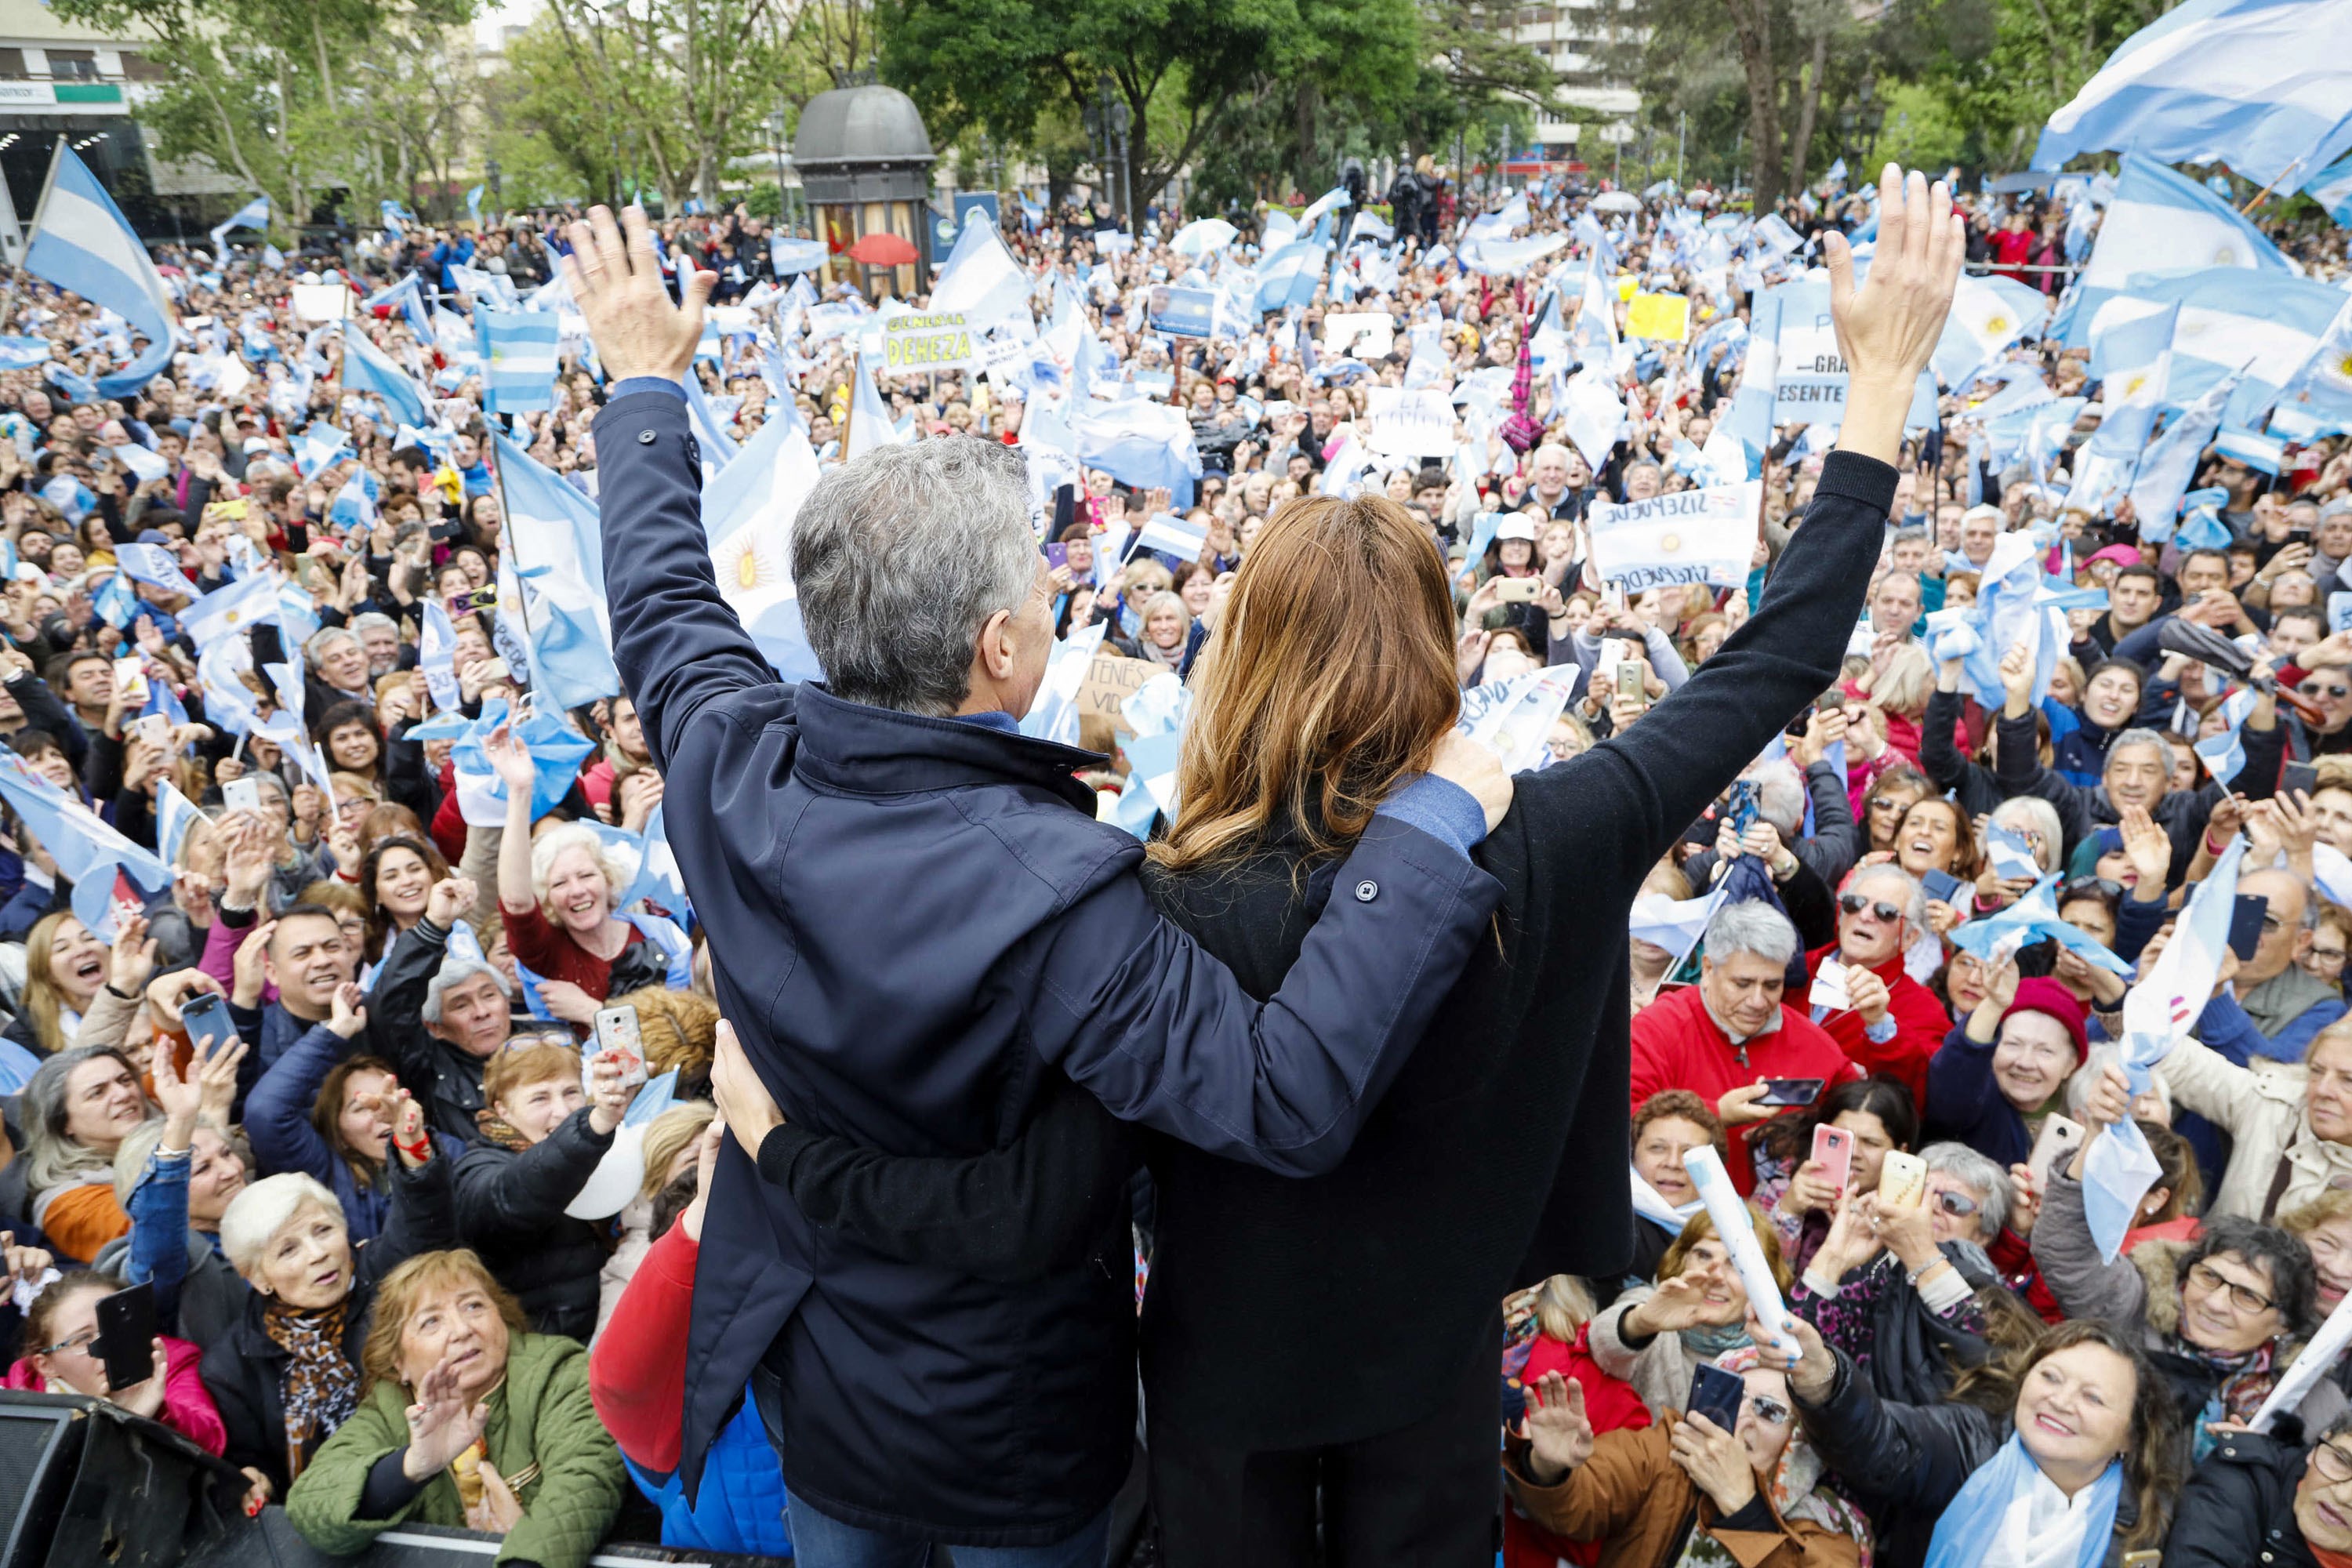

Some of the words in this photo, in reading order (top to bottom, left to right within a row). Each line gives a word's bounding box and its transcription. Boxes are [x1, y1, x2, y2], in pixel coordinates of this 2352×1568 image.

[887, 314, 965, 332] GENERAL
[887, 332, 971, 367] DEHEZA
[1092, 691, 1123, 714] VID
